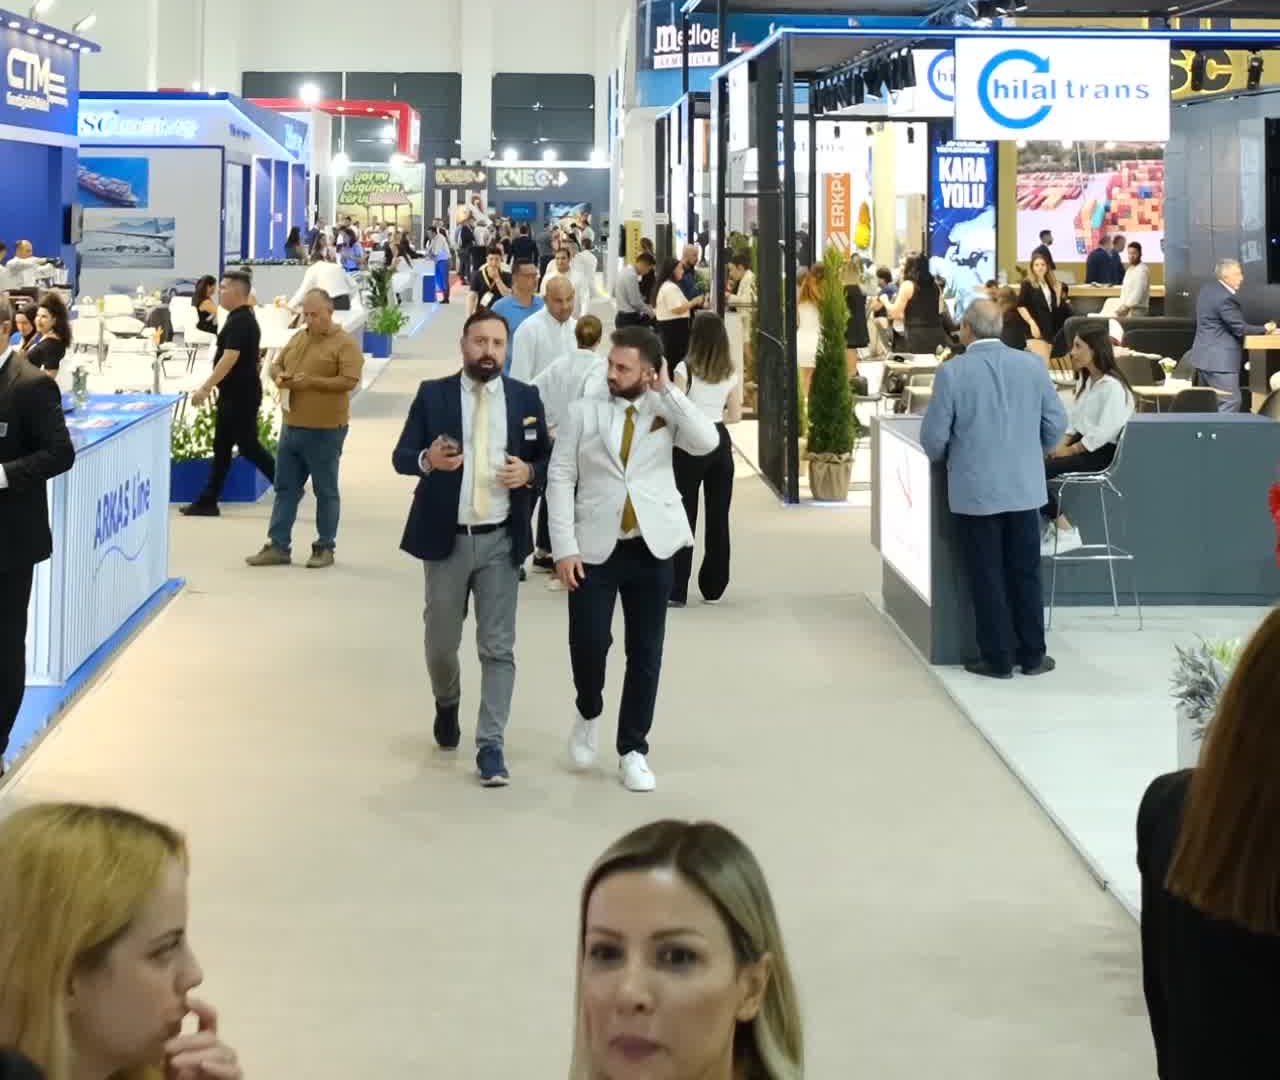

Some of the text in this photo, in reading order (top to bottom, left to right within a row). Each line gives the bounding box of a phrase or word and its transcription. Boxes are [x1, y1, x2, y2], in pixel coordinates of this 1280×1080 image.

[6, 48, 51, 94] CTM
[1067, 82, 1150, 100] trans
[938, 156, 987, 183] KARA
[940, 183, 985, 209] YOLU
[93, 470, 151, 551] ARKAS Line
